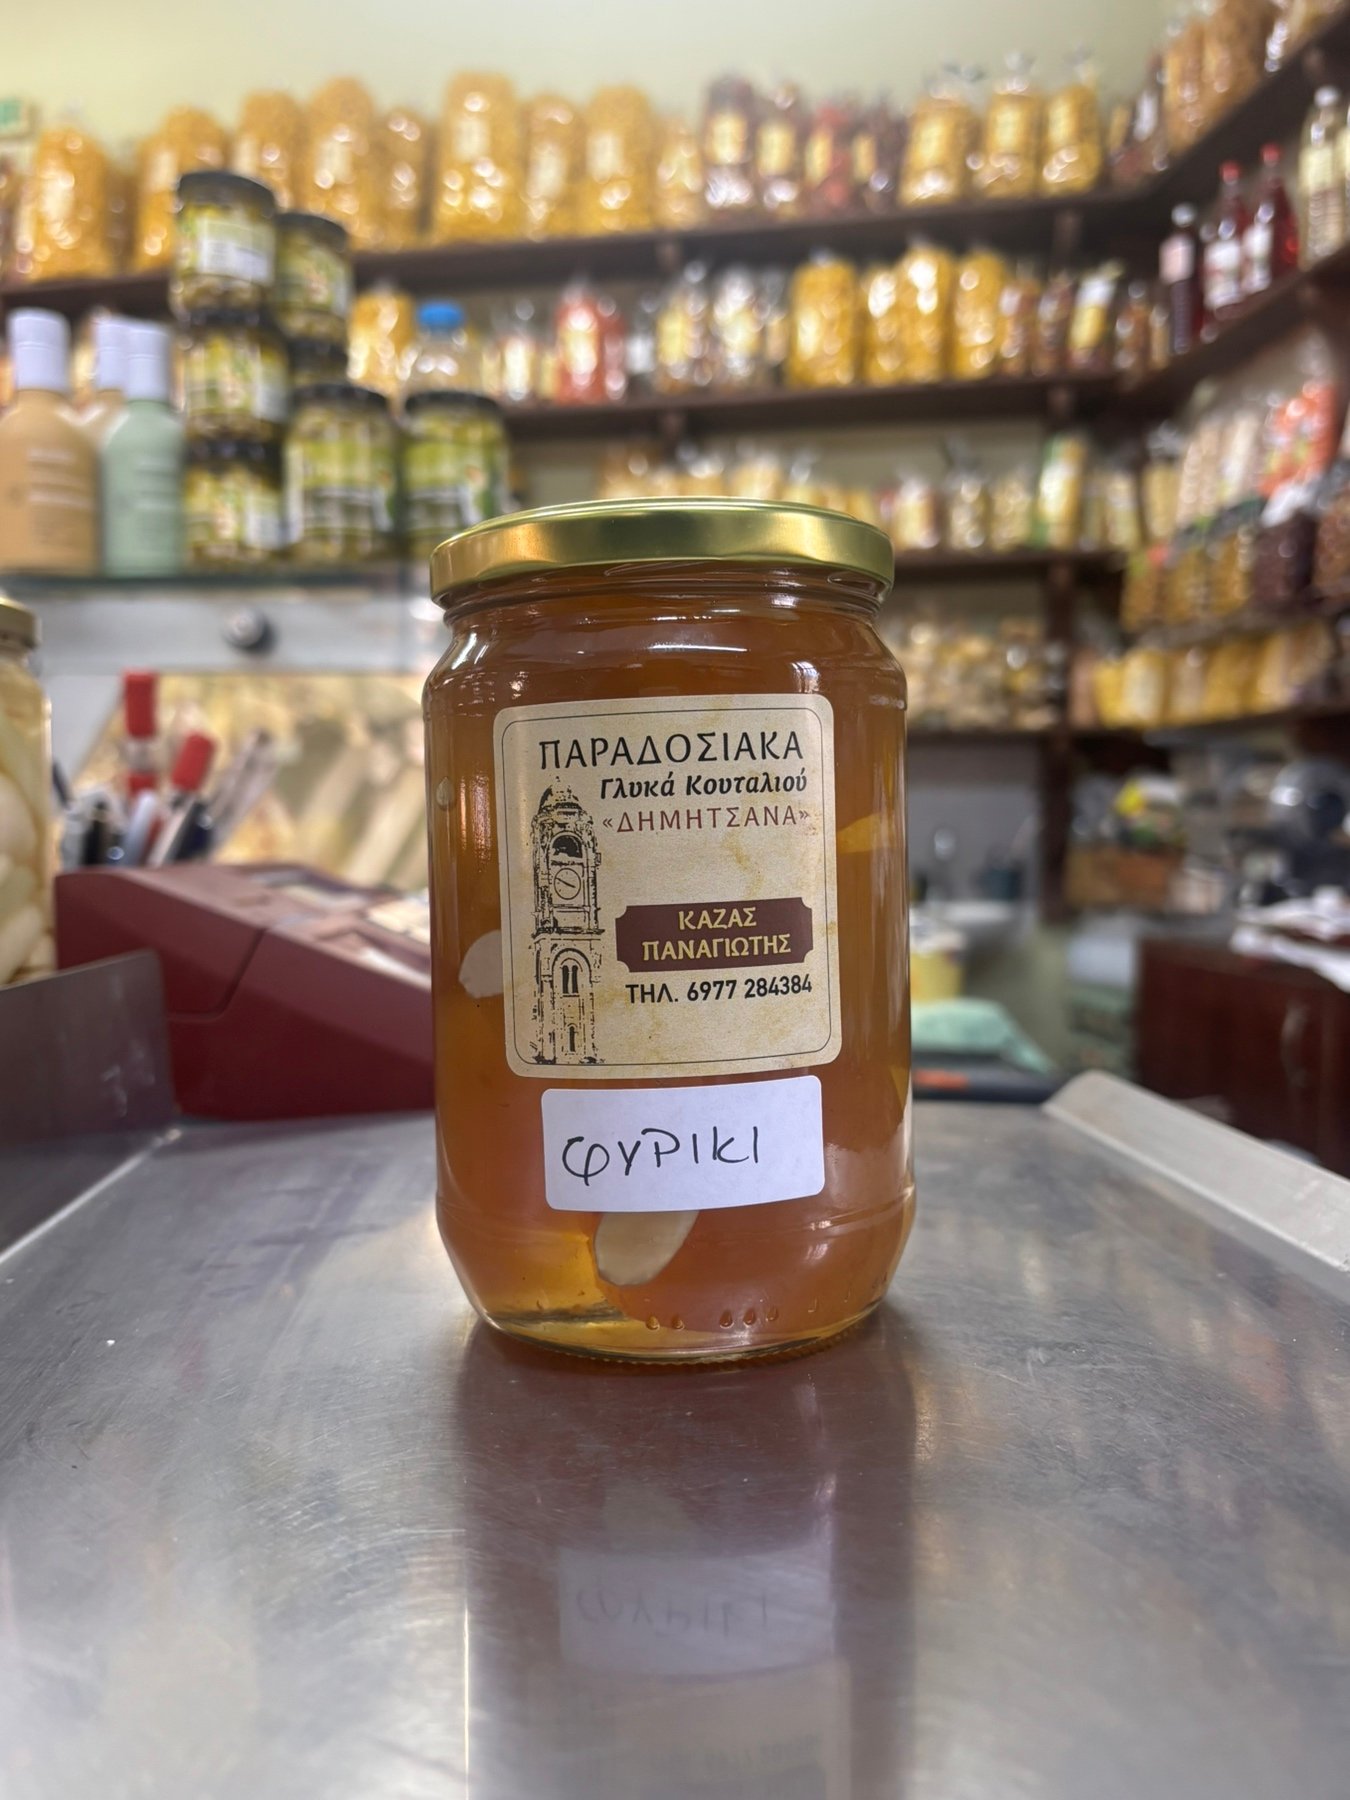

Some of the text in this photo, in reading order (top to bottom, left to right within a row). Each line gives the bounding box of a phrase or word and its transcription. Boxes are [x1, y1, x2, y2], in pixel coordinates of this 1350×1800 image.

[538, 731, 804, 770] ΠΑΡΑΔΟΣΙΑΚΑ
[600, 768, 807, 800] Γλυκά Κουταλιού
[602, 805, 810, 833] «ΔΗΜΗΤΣΑΝΑ»
[678, 907, 757, 931] ΚΑΖΑΣ
[642, 933, 791, 961] ΠΑΝΑΓΙΩΤΗΣ
[625, 974, 812, 1004] ΤΗΛ. 6977 284384
